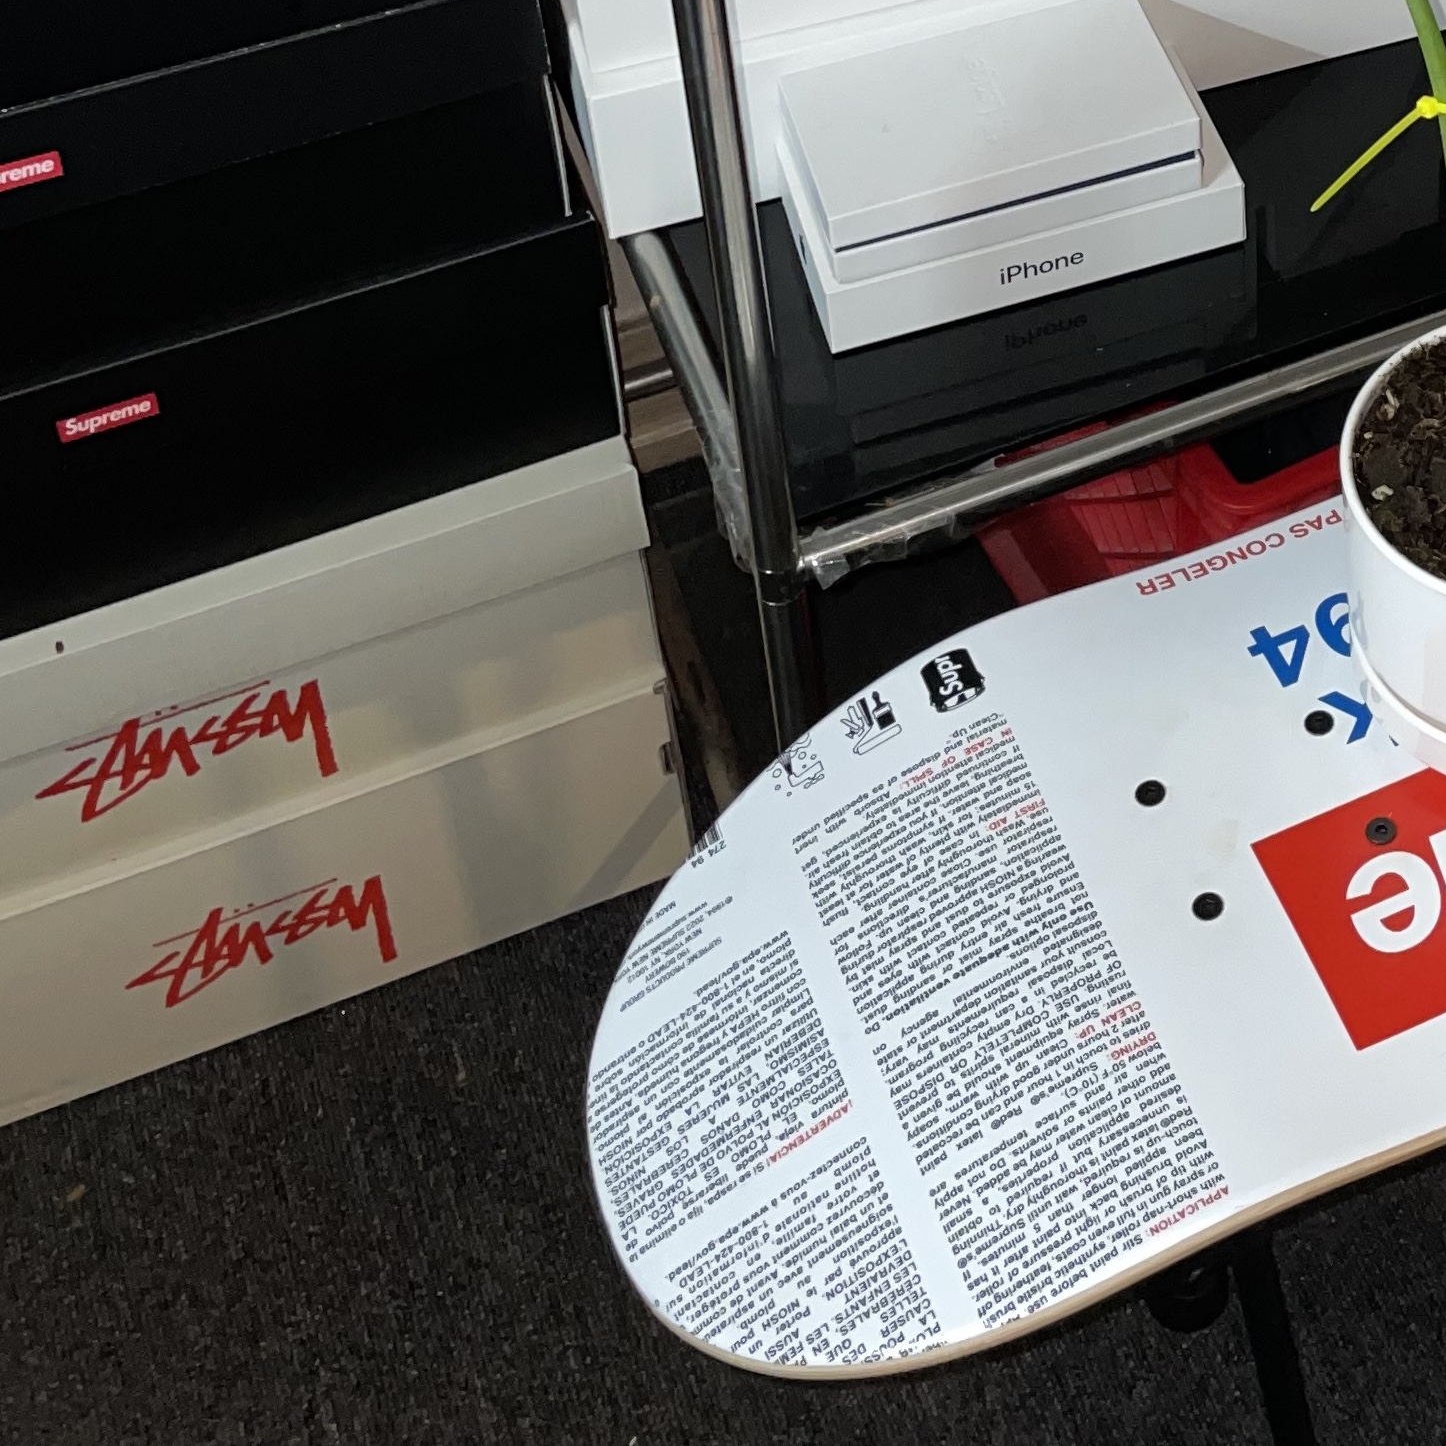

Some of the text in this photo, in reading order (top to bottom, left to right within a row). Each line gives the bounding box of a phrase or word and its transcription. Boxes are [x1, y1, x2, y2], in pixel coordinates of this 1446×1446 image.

[999, 251, 1084, 286] iPhone
[65, 397, 152, 436] Supreme
[1137, 508, 1343, 597] PAS CONGELER
[963, 734, 994, 757] CASE
[1012, 795, 1045, 819] FIRST
[706, 840, 728, 857] 274
[1039, 910, 1068, 933] only
[1068, 898, 1093, 918] Use
[682, 935, 725, 966] SUPREME
[1010, 926, 1040, 948] with
[950, 940, 1011, 982] adequate
[1099, 997, 1142, 1028] CLEAN
[891, 1008, 1050, 1110] COMPLETELY OR DISPOSE
[669, 1108, 764, 1181] ENFERMEDADES
